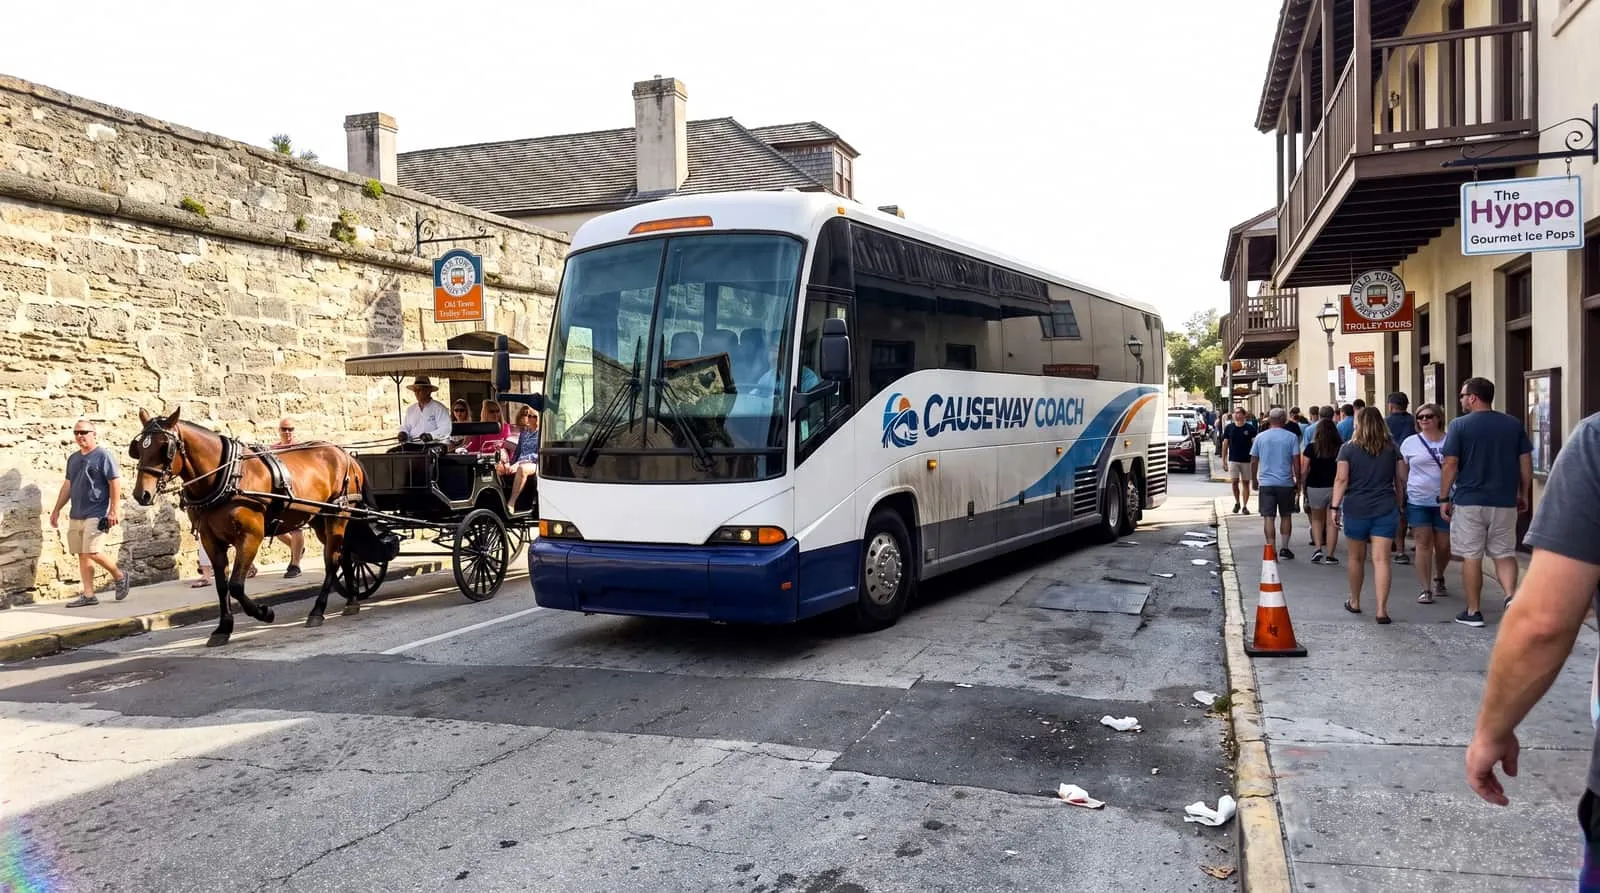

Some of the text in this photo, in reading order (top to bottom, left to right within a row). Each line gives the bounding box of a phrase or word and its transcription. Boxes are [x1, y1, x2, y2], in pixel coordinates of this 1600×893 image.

[1494, 190, 1520, 201] The
[1471, 199, 1574, 228] Hyppo
[1470, 230, 1576, 245] Gourmet Ice Pops
[1374, 271, 1401, 292] TOWN
[456, 300, 475, 308] Town
[440, 308, 480, 318] Trolley Tours
[1345, 320, 1412, 331] TROLLEY TOURS
[924, 393, 1085, 437] CAUSEWAY COACH
